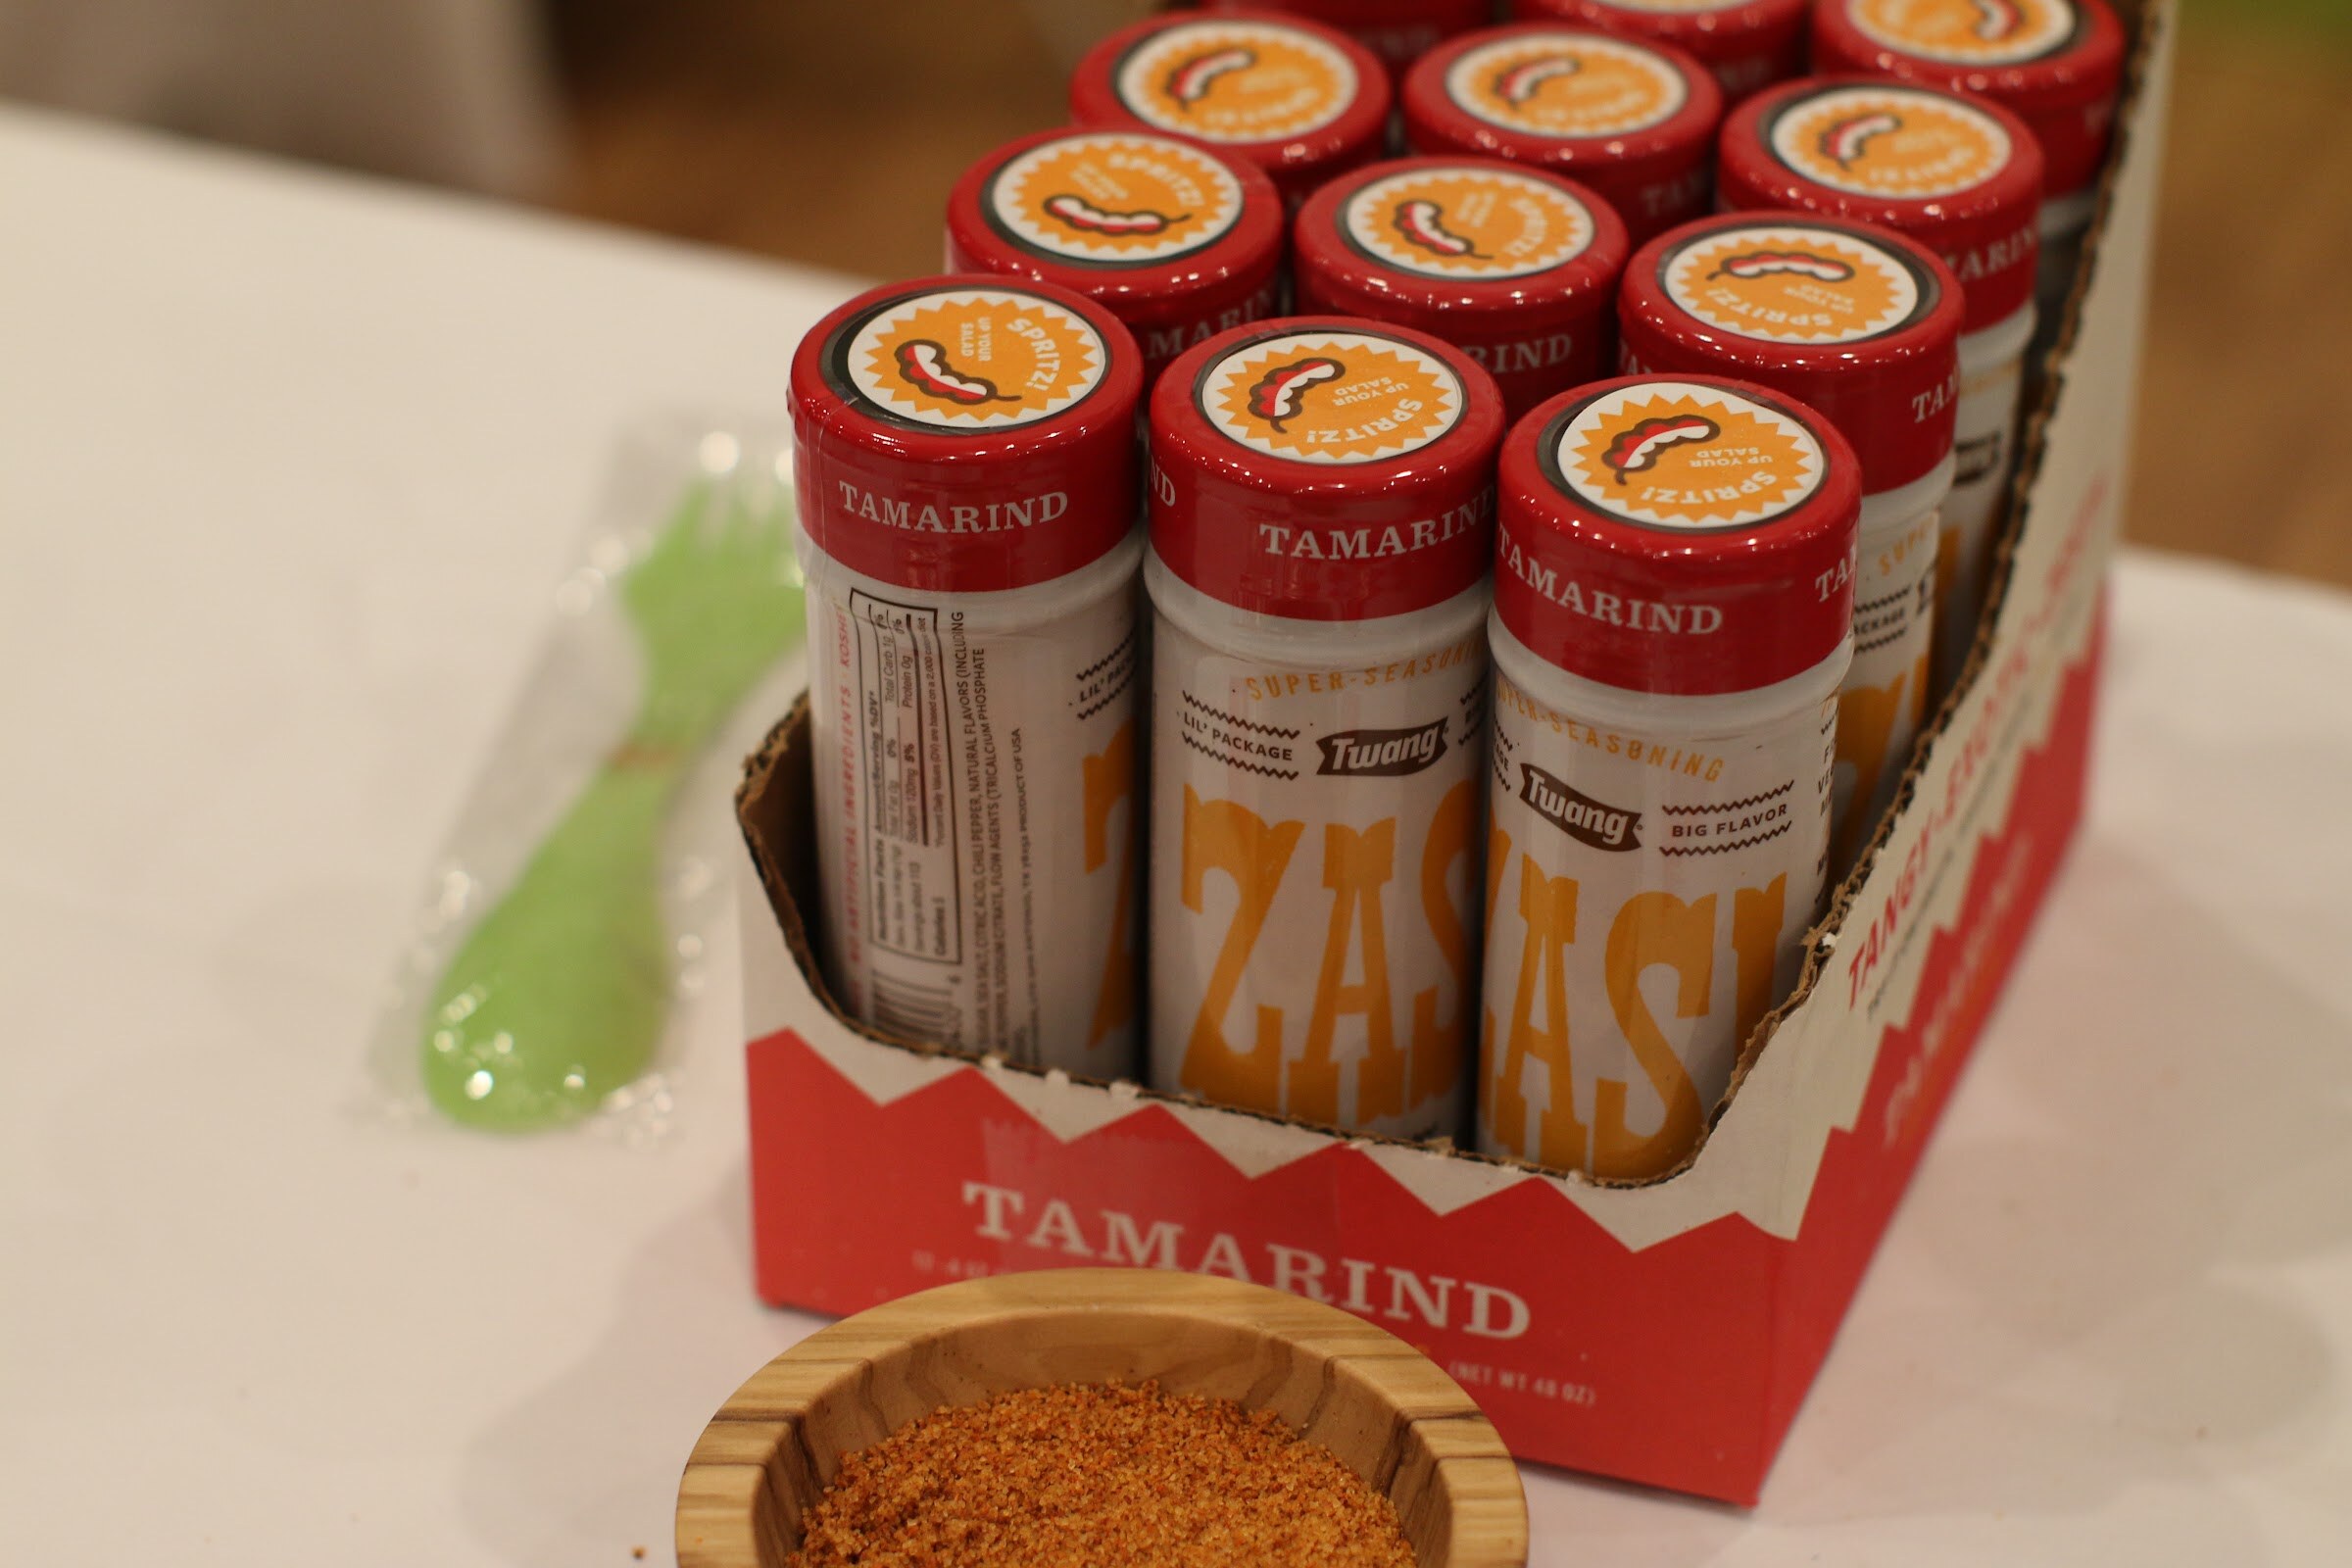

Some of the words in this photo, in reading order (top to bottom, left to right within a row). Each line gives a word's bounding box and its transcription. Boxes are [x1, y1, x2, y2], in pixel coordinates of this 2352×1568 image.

[960, 322, 974, 357] SALAD
[978, 317, 992, 333] UP
[977, 334, 992, 362] YOUR
[1006, 318, 1060, 391] SPRITZ!
[1332, 389, 1382, 406] YOUR
[1334, 376, 1393, 396] SALAD
[1385, 382, 1409, 394] UP
[1306, 399, 1424, 443] SPRITZ!
[1689, 459, 1743, 467] YOUR
[1696, 447, 1760, 458] SALAD
[1747, 455, 1773, 465] UP
[1640, 470, 1778, 504] SPRITZ!
[838, 480, 1068, 533] TAMARIND
[1498, 521, 1724, 635] TAMARIND
[836, 610, 851, 667] KOSHE
[917, 617, 927, 632] diet
[901, 655, 912, 669] 0g
[951, 612, 971, 678] (INCLUDING
[883, 651, 894, 675] Carb
[925, 657, 935, 680] 2,000
[885, 677, 896, 704] Total
[902, 671, 913, 708] Protein
[928, 689, 936, 700] on
[972, 648, 989, 720] PHOSPHATE
[927, 702, 938, 726] based
[957, 681, 977, 735] FLAVORS
[904, 743, 915, 763] 5%
[1011, 729, 1021, 755] USA
[1183, 711, 1207, 730] LIL'
[1211, 728, 1293, 761] PACKAGE
[1330, 725, 1440, 771] Twang
[964, 737, 981, 792] NATURAL
[982, 723, 1002, 800] (TRICALCIUM
[1013, 758, 1023, 772] OF
[969, 794, 984, 841] PEPPER,
[1528, 769, 1630, 845] Twang
[1672, 824, 1707, 839] BIG
[1715, 803, 1788, 837] FLAVOR
[986, 803, 1001, 850] AGENTS
[962, 1180, 1531, 1341] TAMARIND
